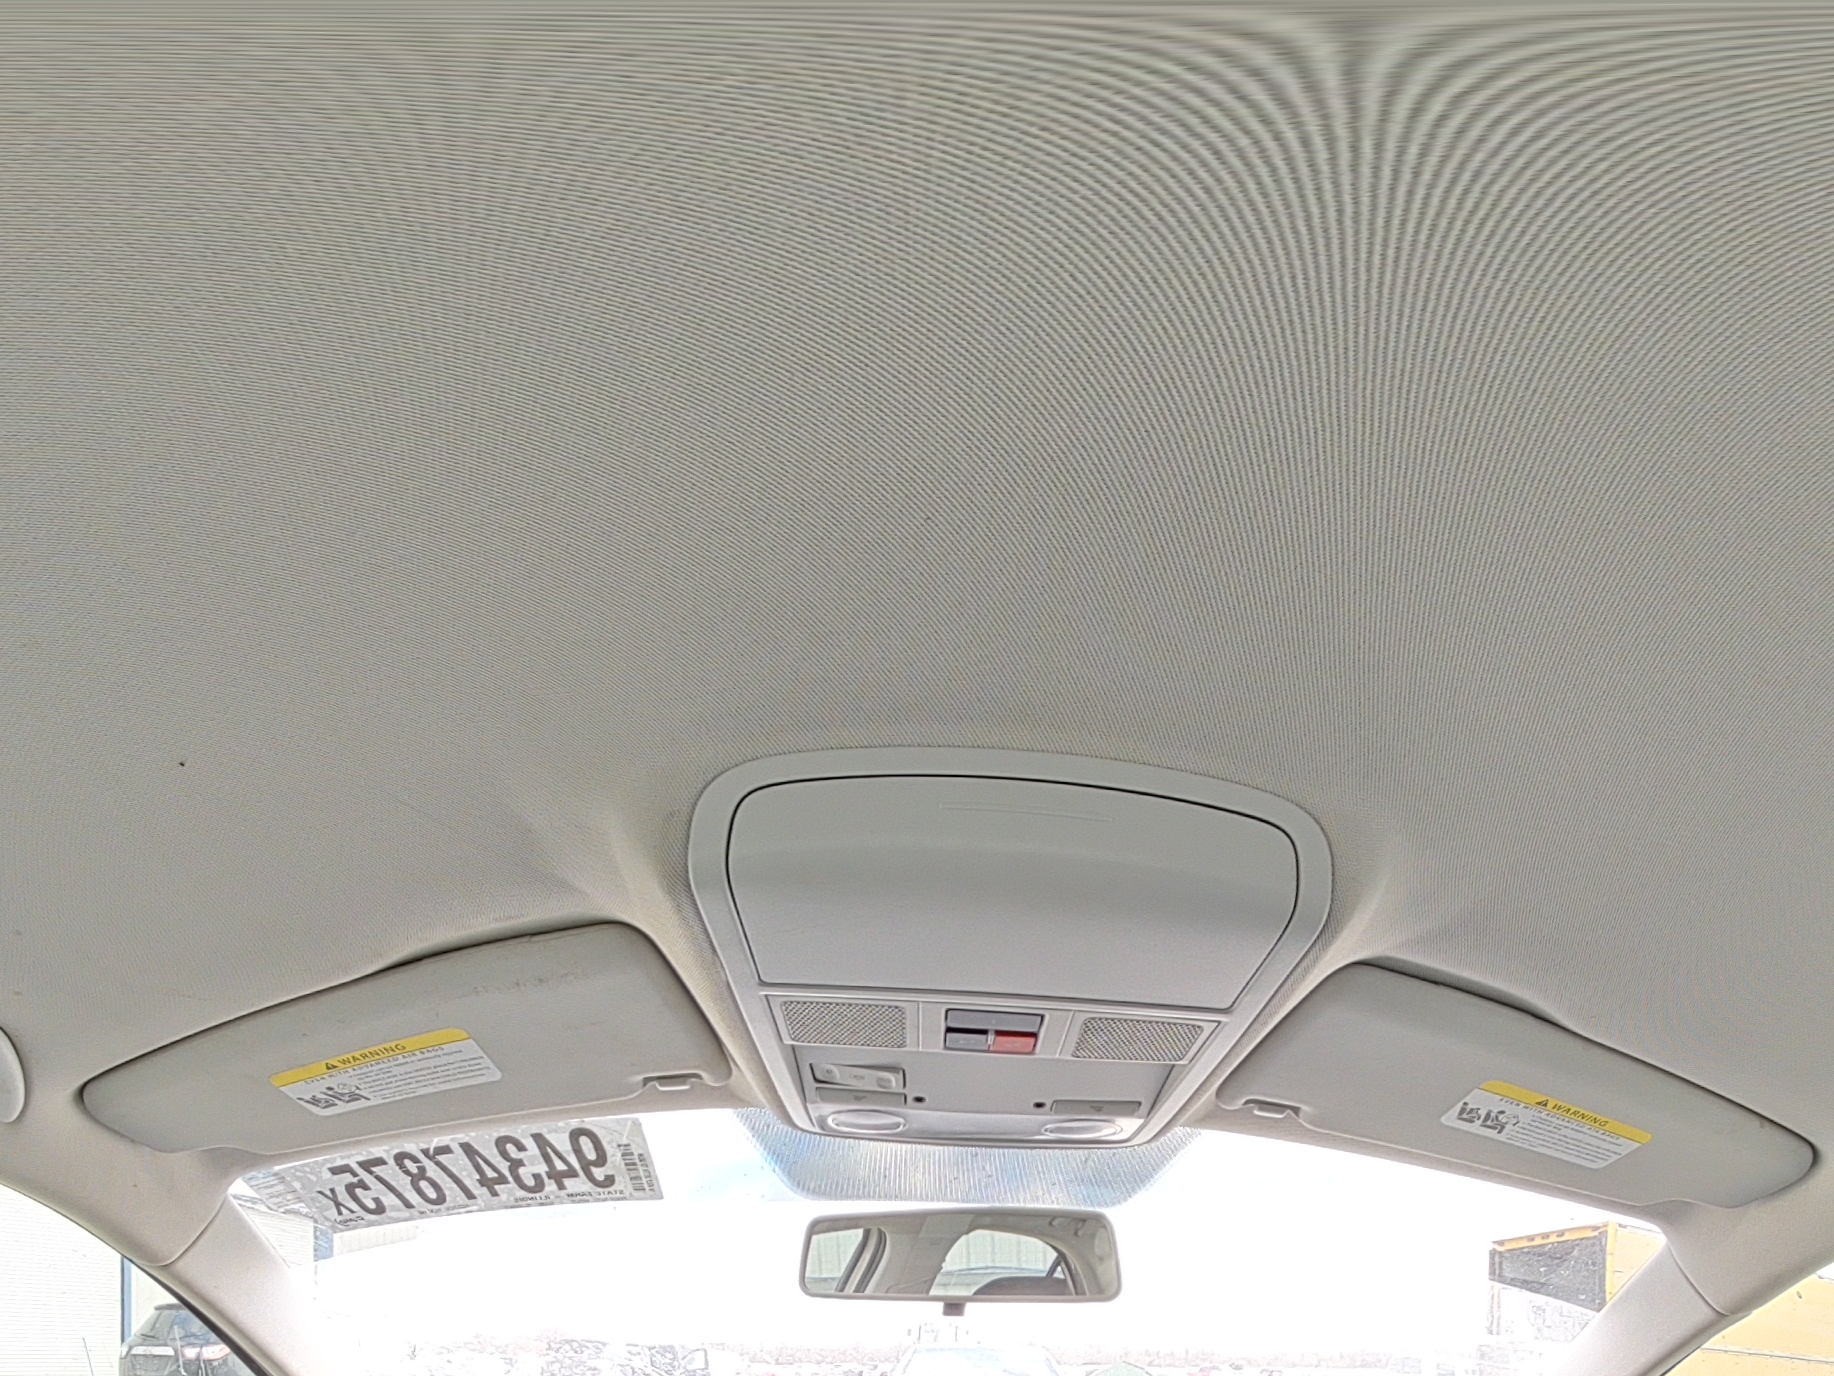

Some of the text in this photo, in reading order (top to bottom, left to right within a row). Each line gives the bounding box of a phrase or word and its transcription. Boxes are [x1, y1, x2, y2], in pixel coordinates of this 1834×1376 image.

[328, 1068, 349, 1079] WITH
[419, 1046, 445, 1055] BAGS
[337, 1043, 407, 1067] WARNING
[1499, 1097, 1521, 1107] EVEN
[1523, 1105, 1544, 1115] WITH
[1552, 1102, 1609, 1127] WARNING
